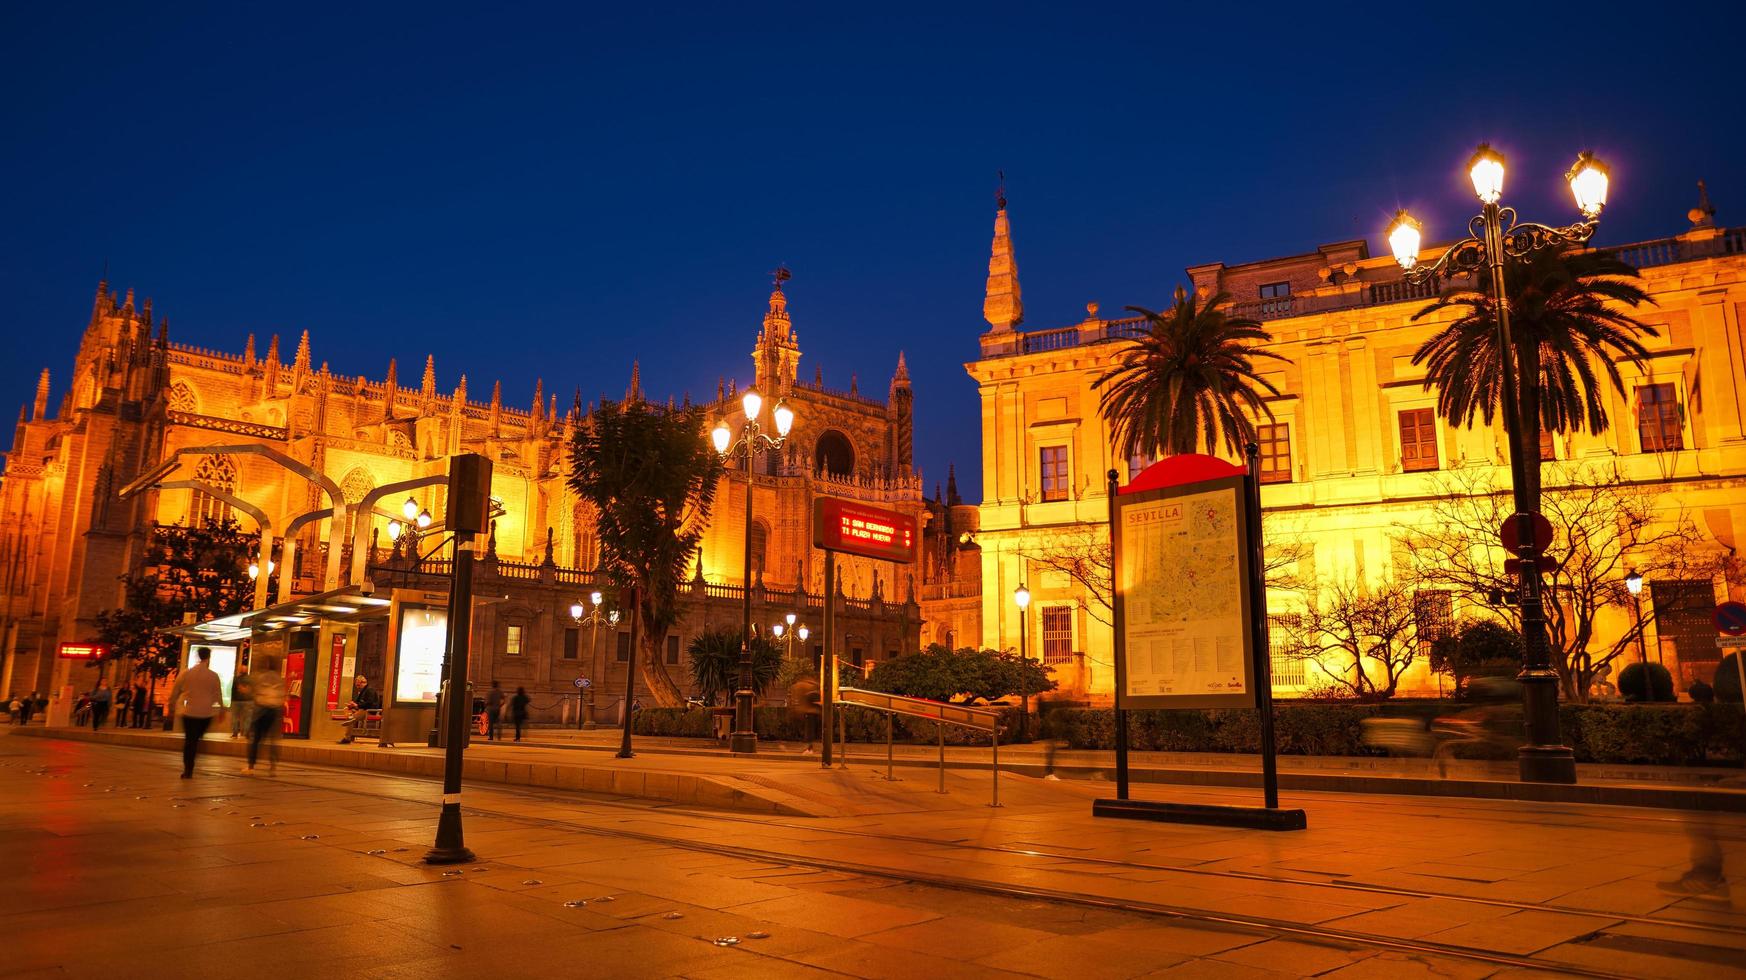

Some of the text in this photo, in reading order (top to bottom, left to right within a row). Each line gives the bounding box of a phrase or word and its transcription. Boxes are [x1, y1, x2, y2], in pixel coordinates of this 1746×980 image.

[1129, 507, 1179, 523] SEVILLA
[852, 519, 865, 528] SAN
[866, 522, 894, 534] BERNARDO
[905, 530, 910, 538] 5
[852, 529, 871, 538] PLAZA
[872, 533, 891, 543] NUEVA
